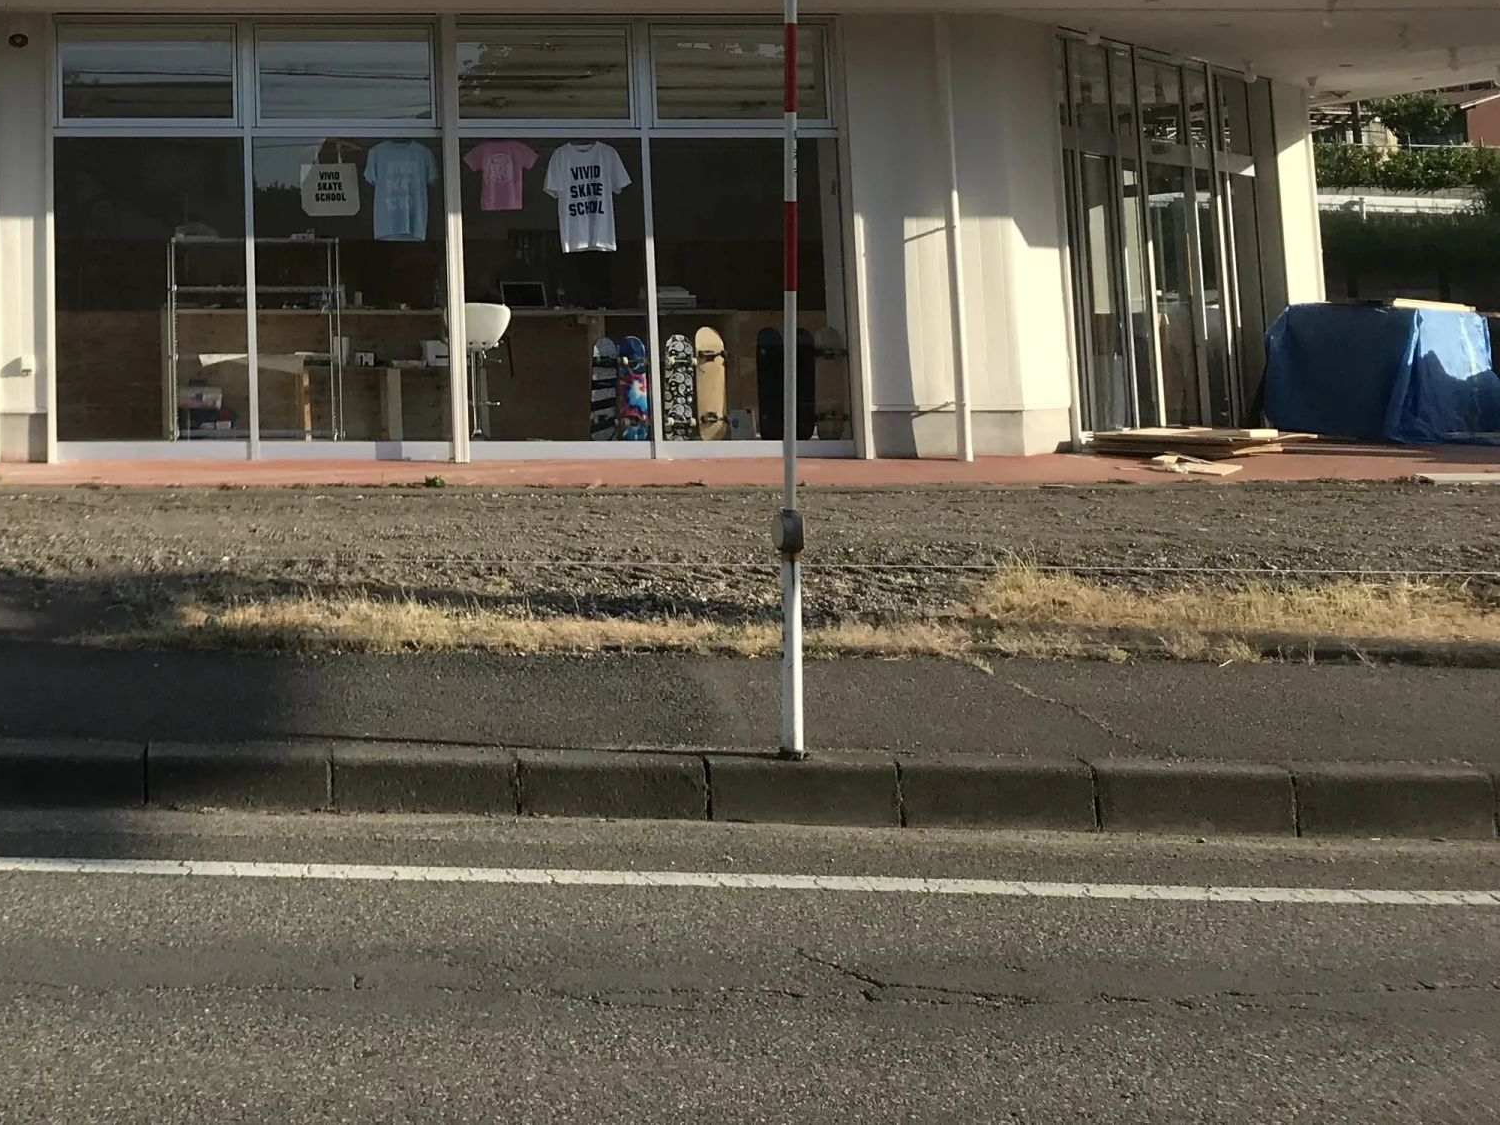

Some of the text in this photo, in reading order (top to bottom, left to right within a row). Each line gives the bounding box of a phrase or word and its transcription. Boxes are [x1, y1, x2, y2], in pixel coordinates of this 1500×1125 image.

[319, 171, 340, 180] VIVID
[570, 165, 601, 180] VIVID
[317, 182, 343, 191] SKATE
[569, 182, 603, 198] SKATE
[315, 192, 347, 202] SCHOOL
